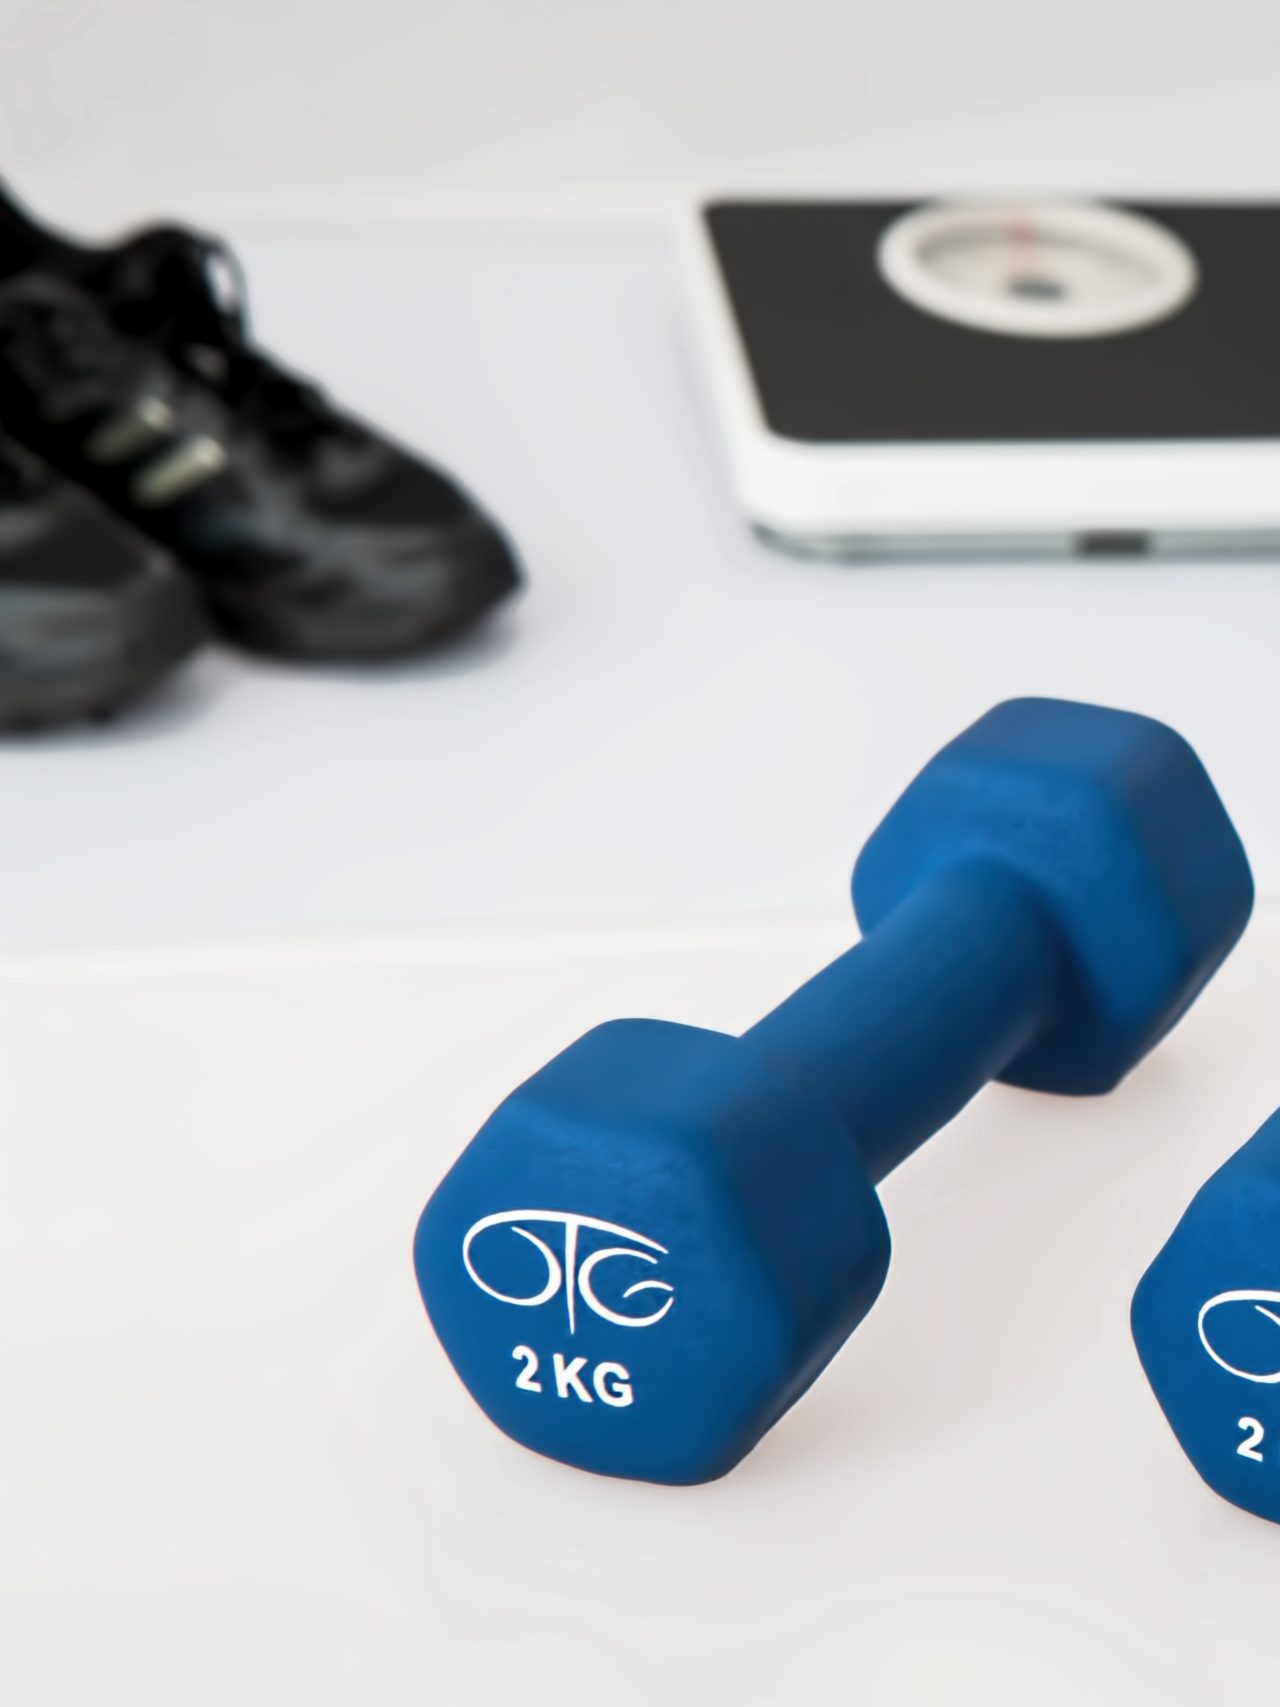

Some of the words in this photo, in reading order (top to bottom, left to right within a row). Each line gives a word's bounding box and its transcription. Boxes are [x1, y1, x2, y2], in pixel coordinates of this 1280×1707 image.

[511, 1345, 542, 1393] 2
[552, 1353, 634, 1408] KG
[1236, 1416, 1265, 1463] 2
